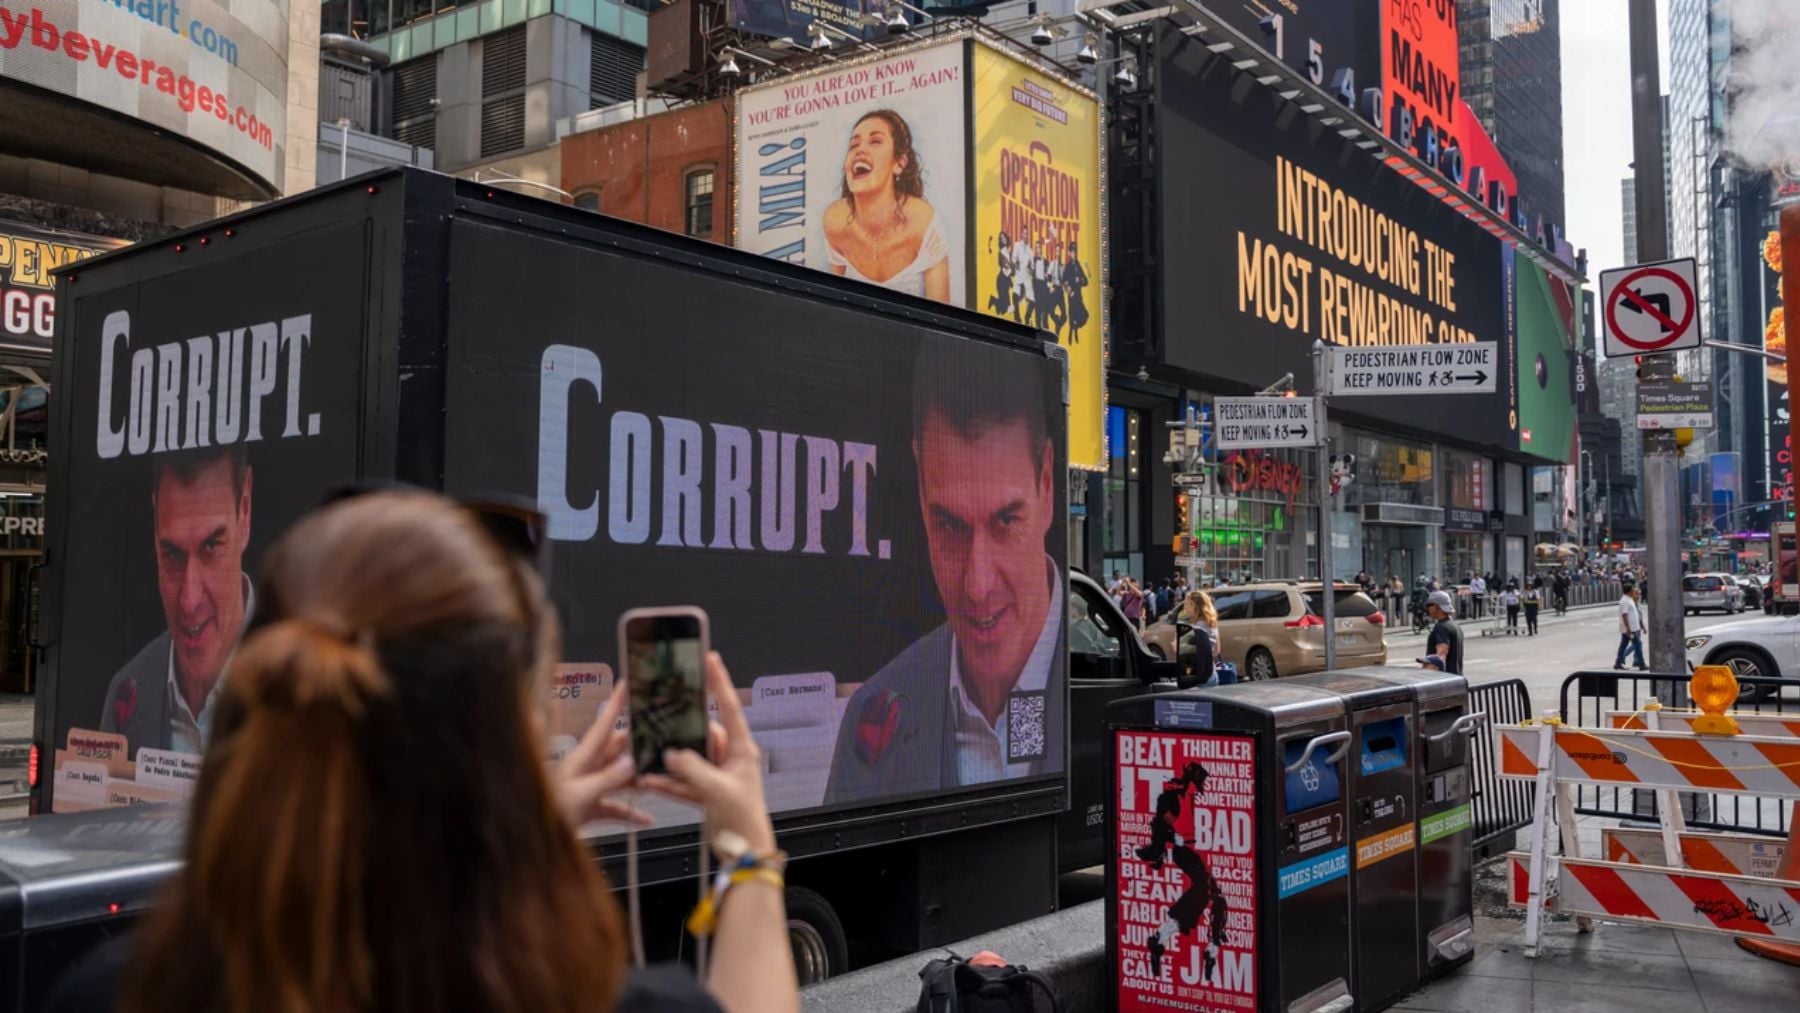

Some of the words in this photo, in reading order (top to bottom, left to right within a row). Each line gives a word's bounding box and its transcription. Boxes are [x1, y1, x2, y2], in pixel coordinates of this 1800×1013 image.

[784, 84, 809, 101] YOU
[813, 69, 871, 96] ALREADY
[875, 58, 918, 80] KNOW
[1391, 28, 1456, 124] MANY
[748, 104, 791, 126] YOU'RE
[794, 94, 840, 116] GONNA
[844, 84, 878, 105] LOVE
[909, 66, 959, 90] AGAIN!
[1001, 148, 1080, 220] OPERATION
[1276, 155, 1420, 295] INTRODUCING
[1423, 239, 1456, 313] THE
[1237, 230, 1312, 334] MOST
[1344, 351, 1417, 368] PEDESTRIAN
[1421, 350, 1453, 366] FLOW
[1457, 349, 1489, 364] ZONE
[1343, 372, 1373, 387] KEEP
[1377, 371, 1422, 386] MOVING
[1640, 394, 1666, 402] Times
[1668, 393, 1700, 402] Square
[1640, 403, 1685, 412] Pedestrian
[1686, 402, 1709, 411] Plaza
[1220, 404, 1266, 420] PEDESTRIAN
[1267, 404, 1288, 419] FLOW
[1288, 403, 1307, 418] ZONE
[1221, 426, 1240, 441] KEEP
[1242, 425, 1271, 440] MOVING
[1120, 735, 1177, 767] BEAT
[1182, 739, 1252, 761] THRILLER
[1239, 763, 1252, 778] BE
[1121, 766, 1175, 812] IT
[1203, 777, 1255, 793] STARTIN'
[1193, 806, 1253, 855] BAD
[1422, 820, 1444, 838] TIMES
[1444, 809, 1470, 830] SQUARE
[1358, 843, 1384, 862] TIMES
[1384, 830, 1413, 850] SQUARE
[1121, 862, 1183, 885] BILLIE
[1212, 855, 1234, 868] WANT
[1236, 857, 1253, 869] YOU
[1280, 869, 1310, 891] TIMES
[1312, 854, 1347, 881] SQUARE
[1212, 867, 1253, 881] BACK
[1121, 880, 1184, 903] JEAN
[1122, 948, 1145, 961] THEY
[1180, 944, 1254, 994] JAM
[1122, 977, 1158, 993] ABOUT
[1159, 982, 1175, 995] US
